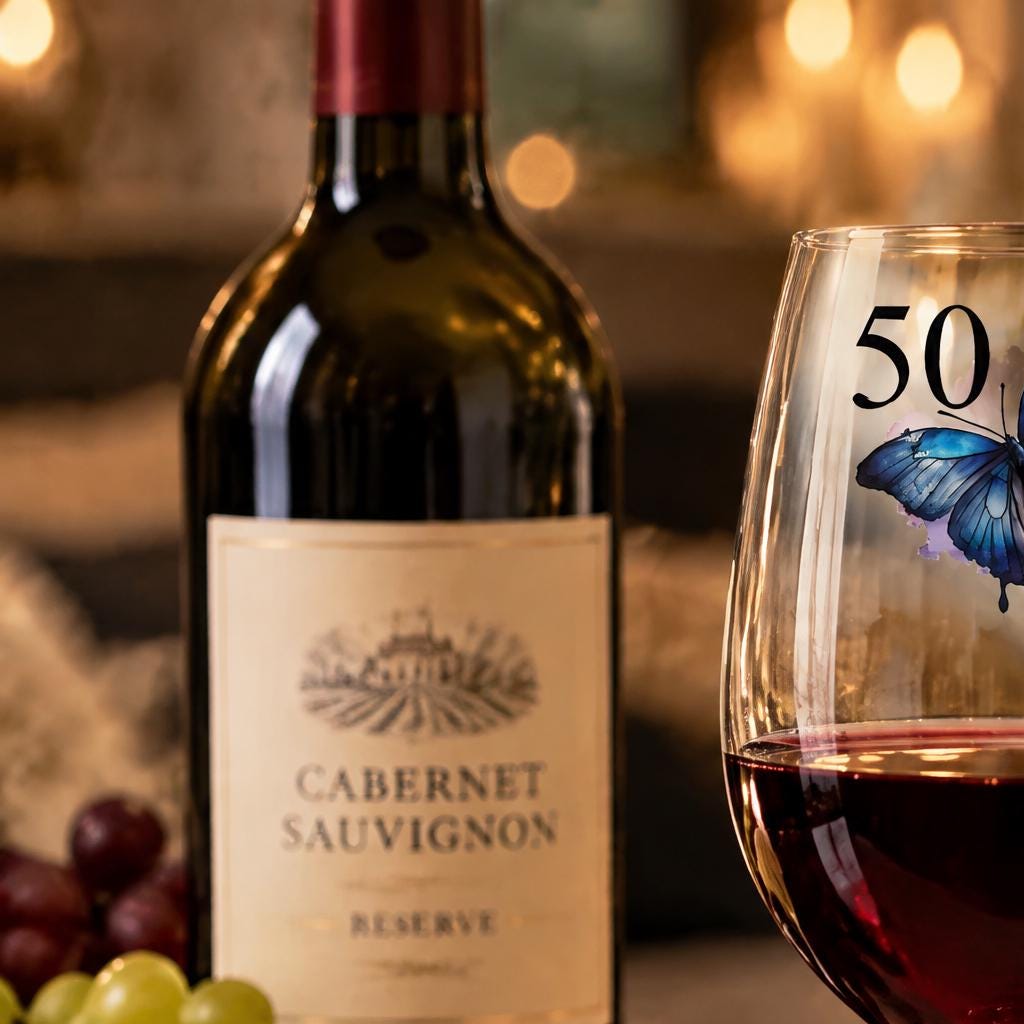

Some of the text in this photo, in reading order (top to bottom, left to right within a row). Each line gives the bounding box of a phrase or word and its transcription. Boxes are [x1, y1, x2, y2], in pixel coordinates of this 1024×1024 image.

[852, 304, 990, 409] 50
[295, 761, 546, 803] CABERNET
[281, 811, 558, 853] SAUVIGNON
[349, 911, 496, 938] RESERVE
